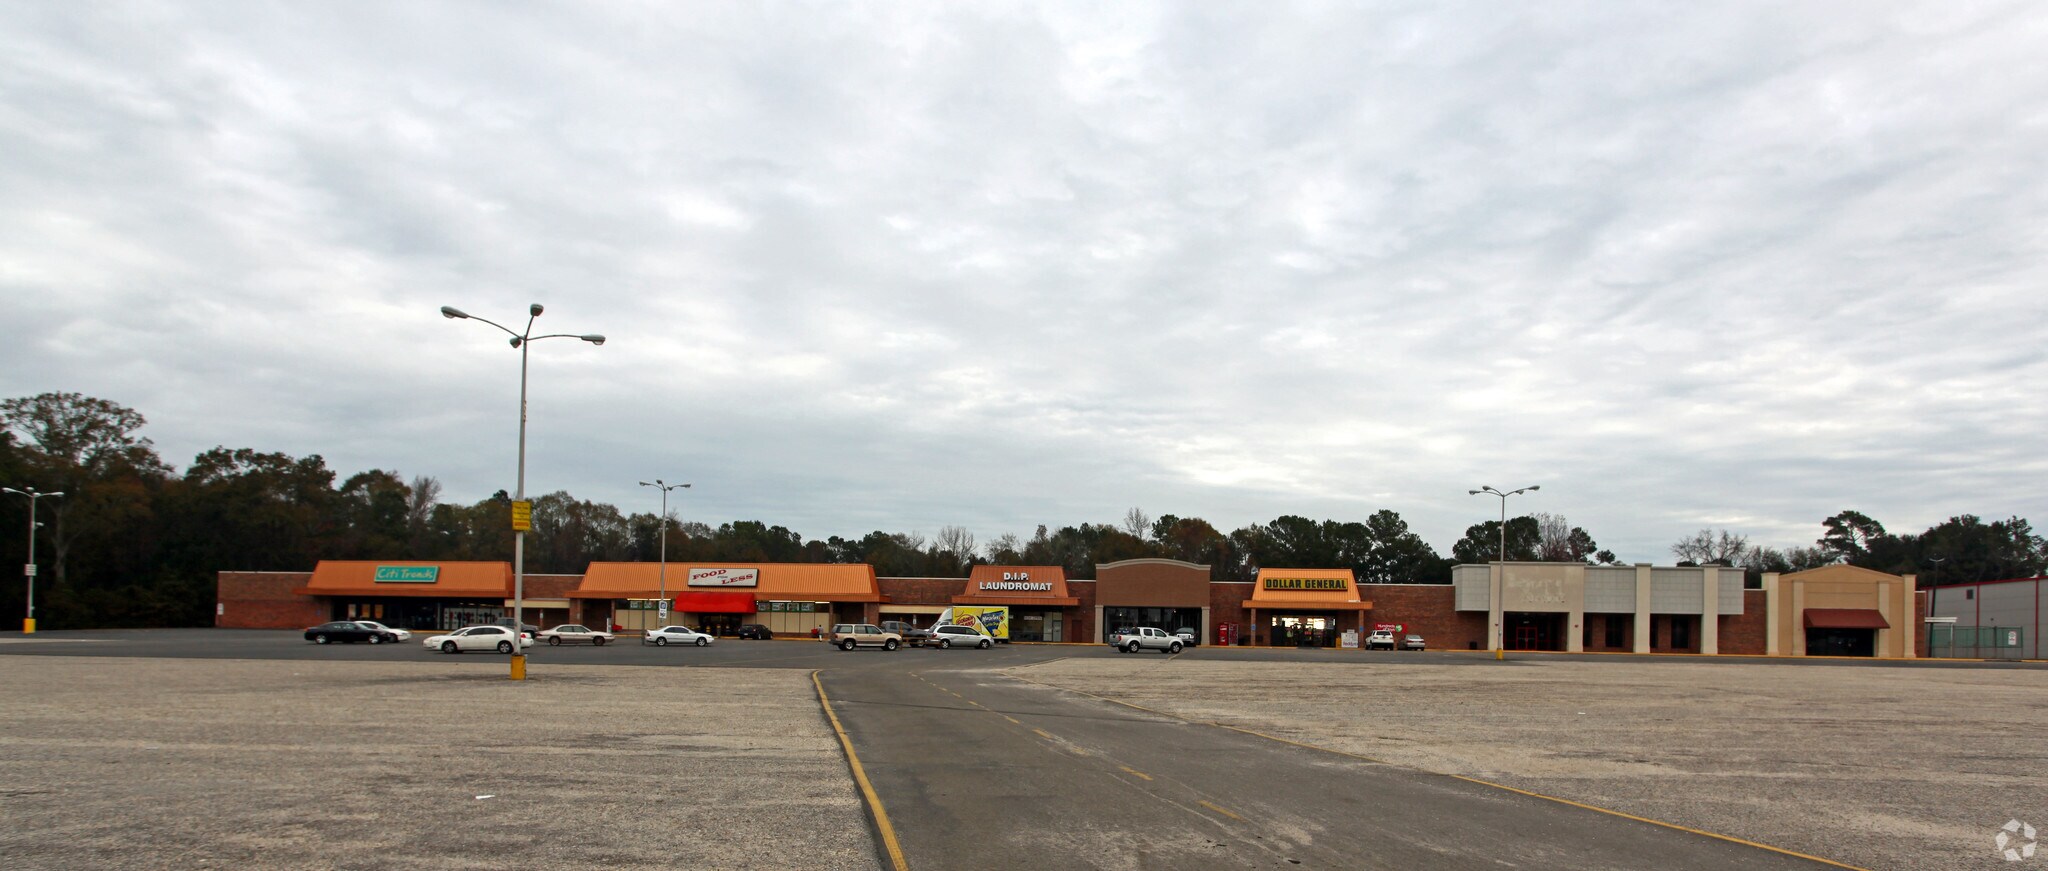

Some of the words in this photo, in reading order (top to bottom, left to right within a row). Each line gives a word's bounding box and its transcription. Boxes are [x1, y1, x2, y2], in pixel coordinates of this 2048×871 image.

[377, 568, 399, 578] Citi
[692, 569, 727, 580] FOOD
[1003, 572, 1029, 580] D.I.P.
[722, 574, 754, 585] LESS
[1266, 579, 1301, 588] DOLLAR
[1305, 580, 1347, 589] GENERAL
[979, 582, 1053, 591] LAUNDROMAT
